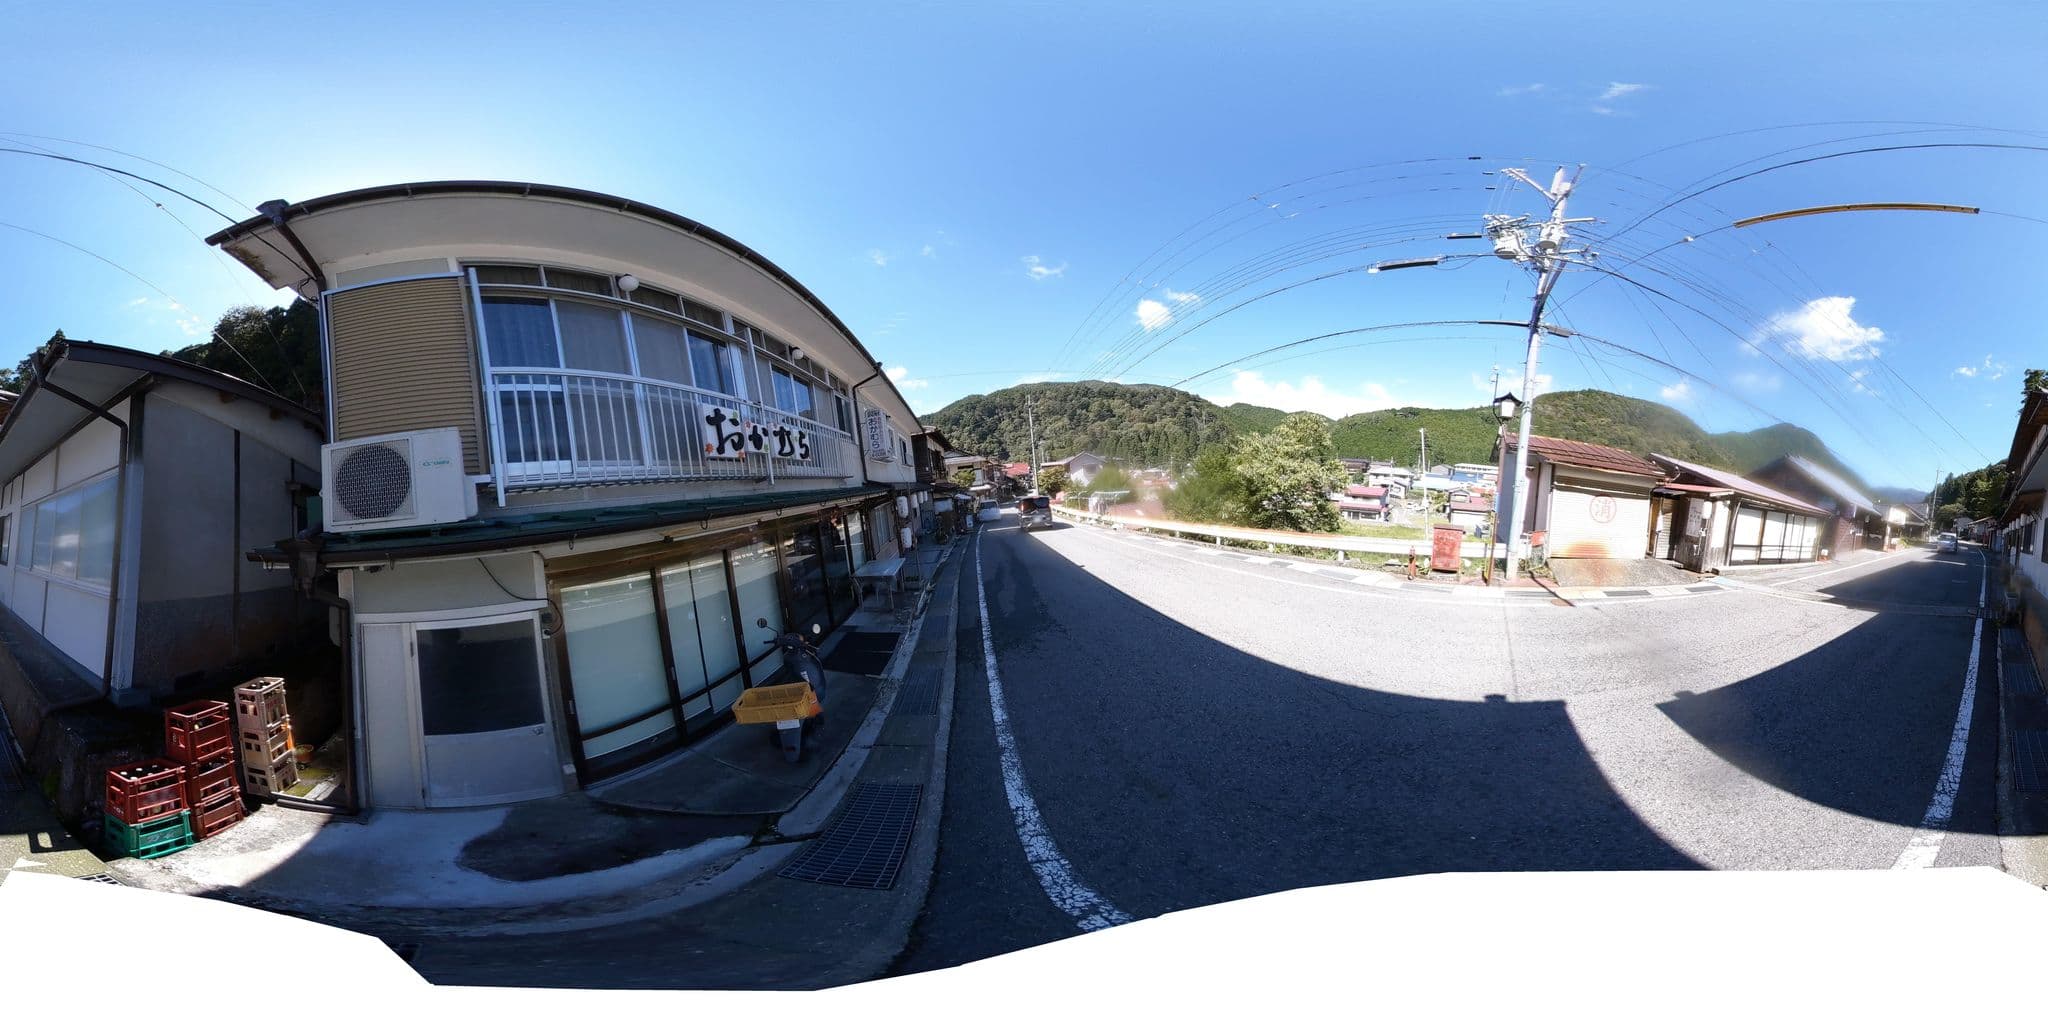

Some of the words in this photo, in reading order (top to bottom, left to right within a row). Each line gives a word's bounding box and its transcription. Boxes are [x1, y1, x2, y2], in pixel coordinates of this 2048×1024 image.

[706, 408, 809, 459] おかむら
[868, 418, 880, 449] おかむら
